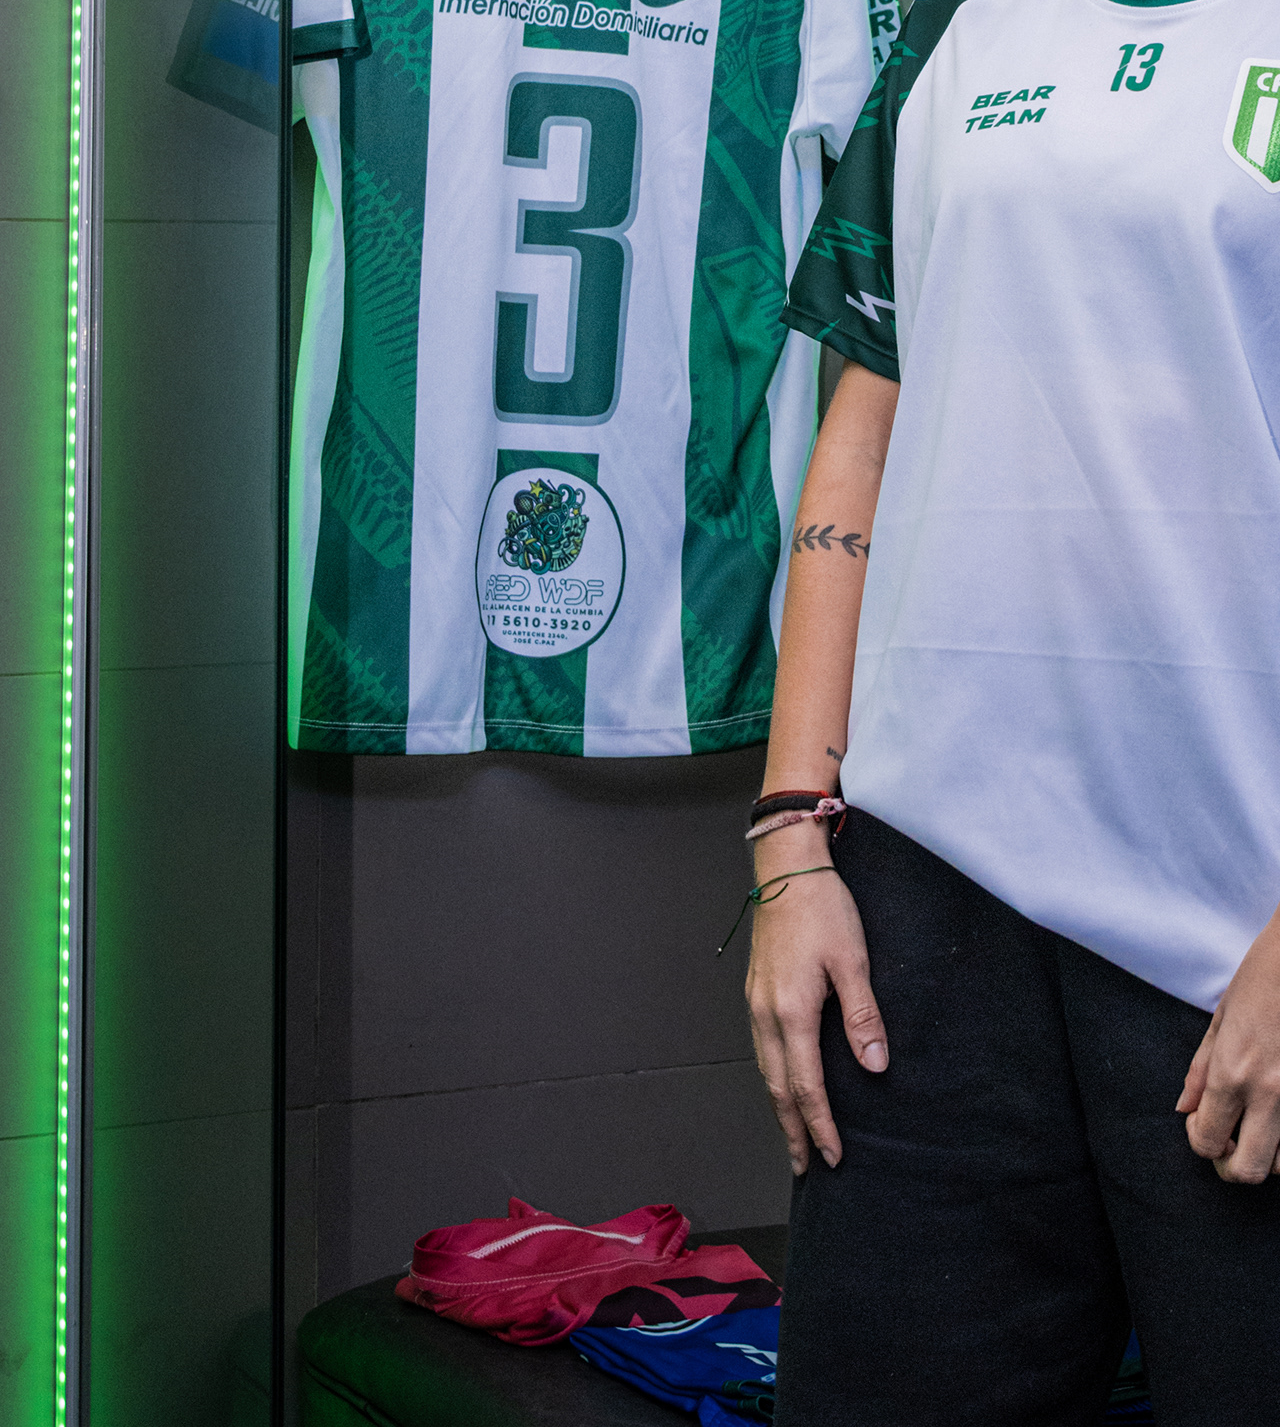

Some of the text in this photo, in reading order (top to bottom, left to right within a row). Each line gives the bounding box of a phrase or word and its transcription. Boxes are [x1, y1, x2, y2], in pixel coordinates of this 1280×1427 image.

[573, 1, 709, 46] Domiciliaria
[1110, 42, 1165, 93] 13
[970, 84, 1056, 111] BEAR
[964, 107, 1047, 134] TEAM
[492, 72, 643, 426] 3
[482, 603, 604, 616] EL ALMACEN DE LA CUMBIA
[502, 615, 591, 631] 5610-3920
